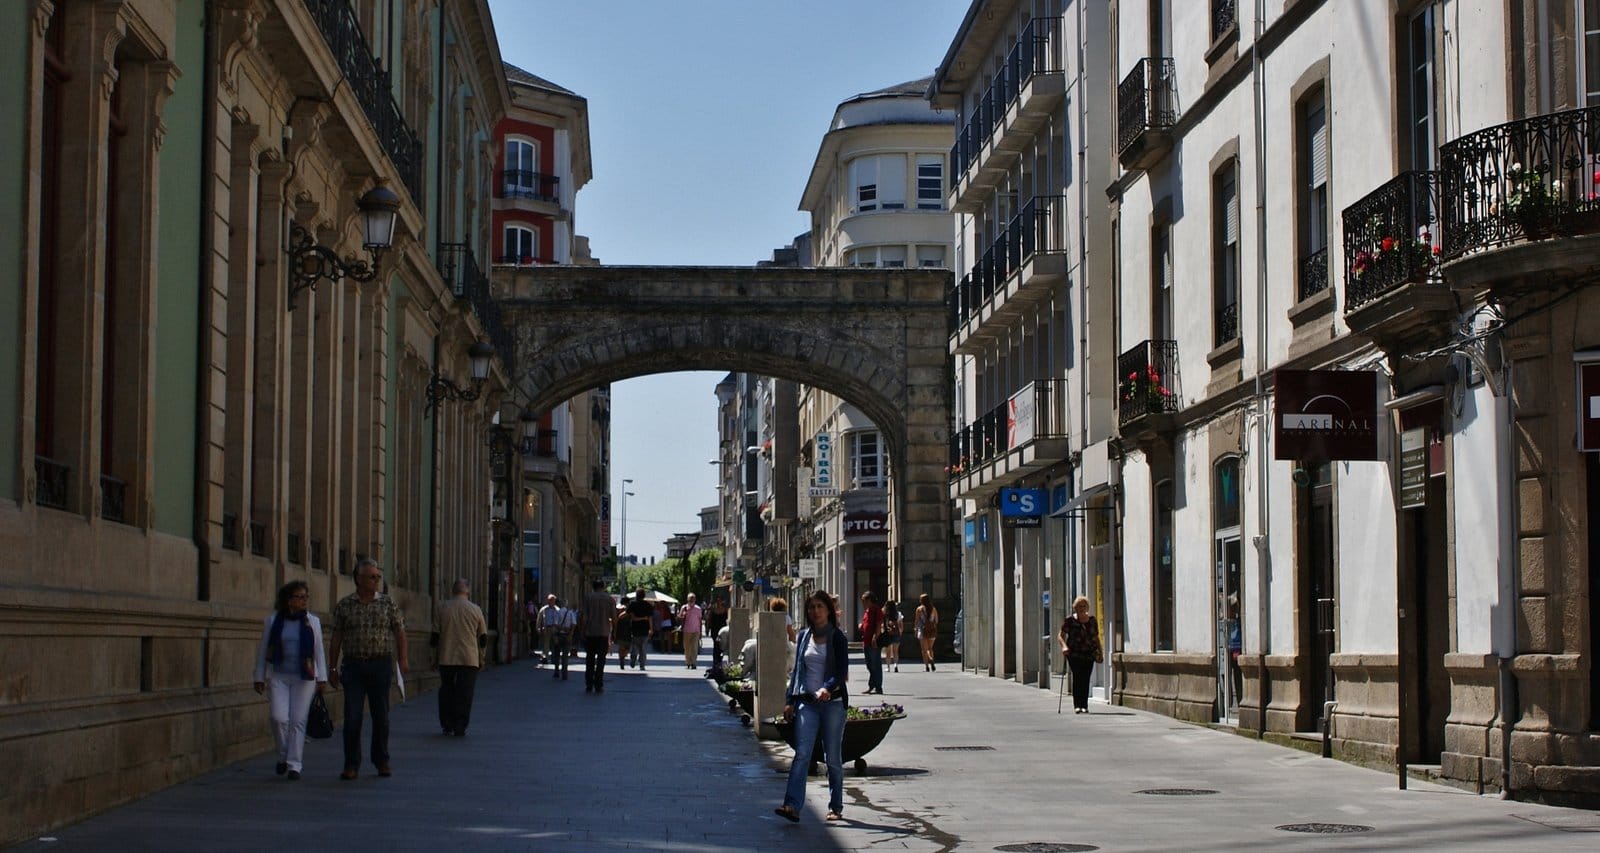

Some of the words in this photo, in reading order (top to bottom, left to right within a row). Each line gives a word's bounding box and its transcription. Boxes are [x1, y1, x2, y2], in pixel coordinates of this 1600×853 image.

[1297, 419, 1370, 430] ARENAL
[818, 435, 829, 484] ROIBAS
[1020, 494, 1035, 513] S
